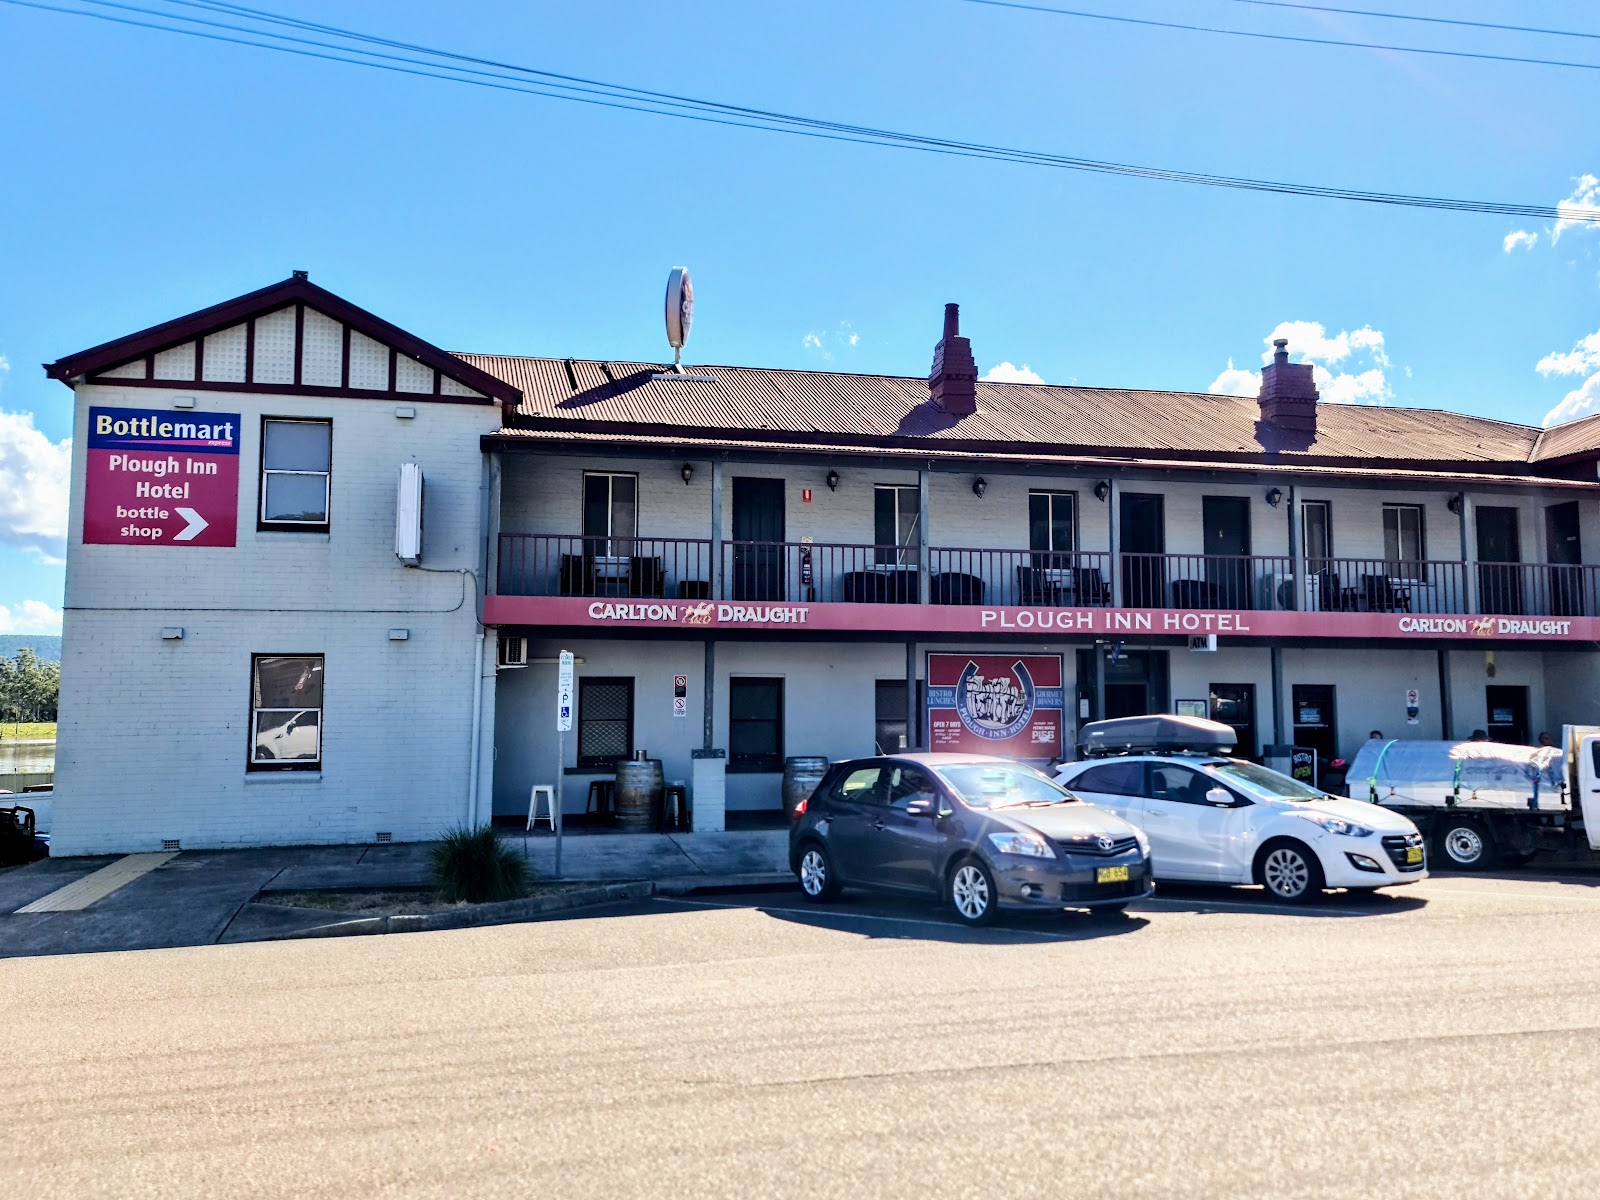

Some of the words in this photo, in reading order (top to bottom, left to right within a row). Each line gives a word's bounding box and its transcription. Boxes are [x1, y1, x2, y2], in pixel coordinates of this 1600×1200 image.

[96, 415, 233, 440] Bottlemart
[109, 455, 179, 477] Plough
[187, 458, 217, 474] Inn
[136, 482, 189, 499] Hotel
[116, 505, 169, 519] bottle
[121, 524, 162, 539] shop
[588, 602, 677, 621] CARLTON
[717, 605, 809, 623] DRAUGHT
[981, 610, 1093, 628] PLOUGH
[1105, 613, 1152, 629] INN
[1163, 613, 1250, 631] HOTEL
[1399, 617, 1467, 633] CARLTON
[1498, 618, 1571, 635] DRAUGHT
[1190, 637, 1207, 648] ATM
[1036, 690, 1063, 698] GOURMET
[960, 707, 986, 735] PLOUGH
[1010, 708, 1031, 734] HOTEL
[1293, 752, 1312, 764] BISTRO
[1294, 765, 1312, 778] OPEN
